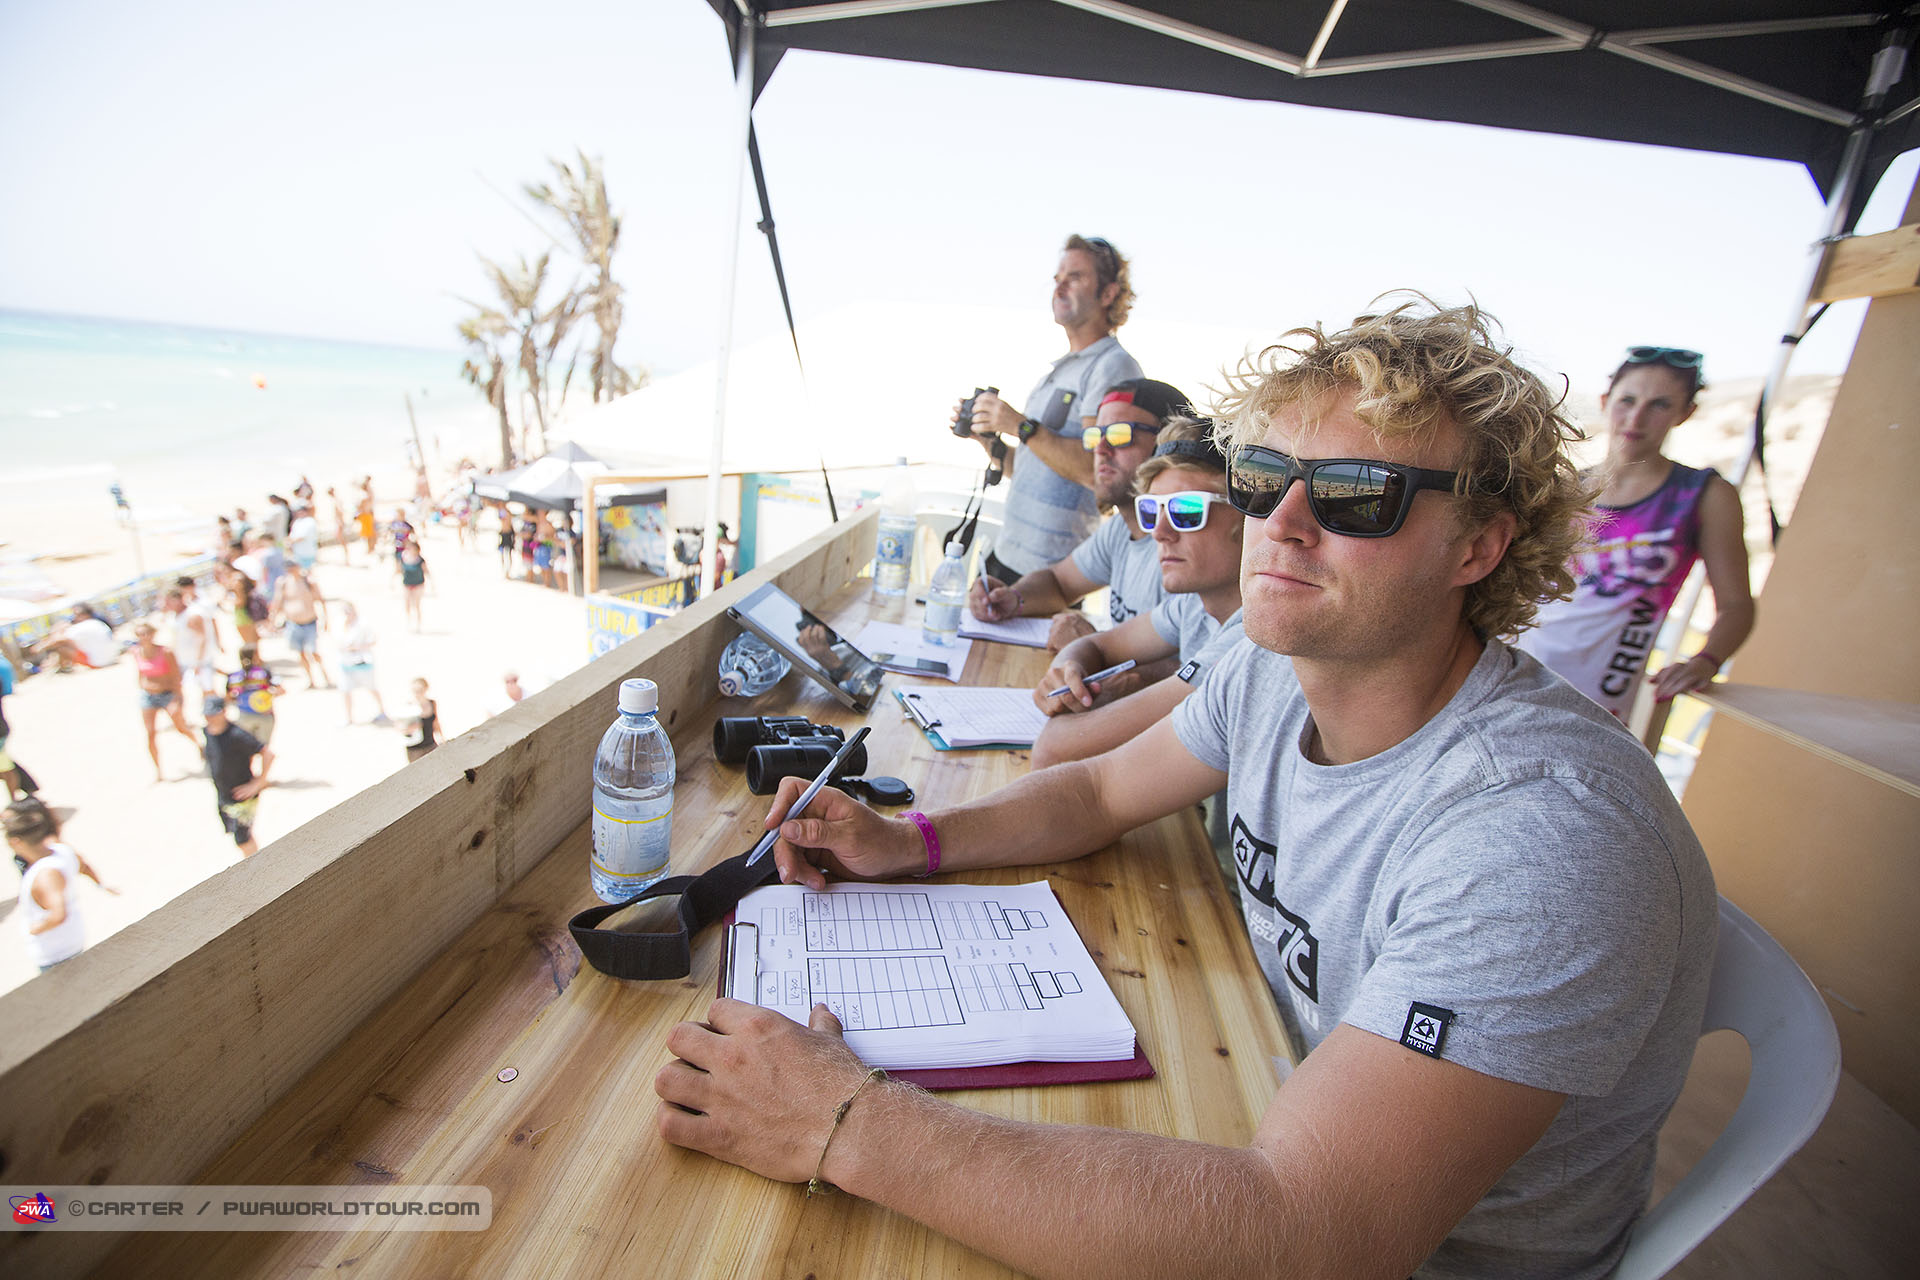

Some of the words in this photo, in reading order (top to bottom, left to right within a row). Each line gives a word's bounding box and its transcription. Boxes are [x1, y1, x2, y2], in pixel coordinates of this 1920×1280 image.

[1600, 597, 1658, 697] CREW
[1250, 850, 1311, 989] MIC
[1406, 1036, 1435, 1053] MYSTIC
